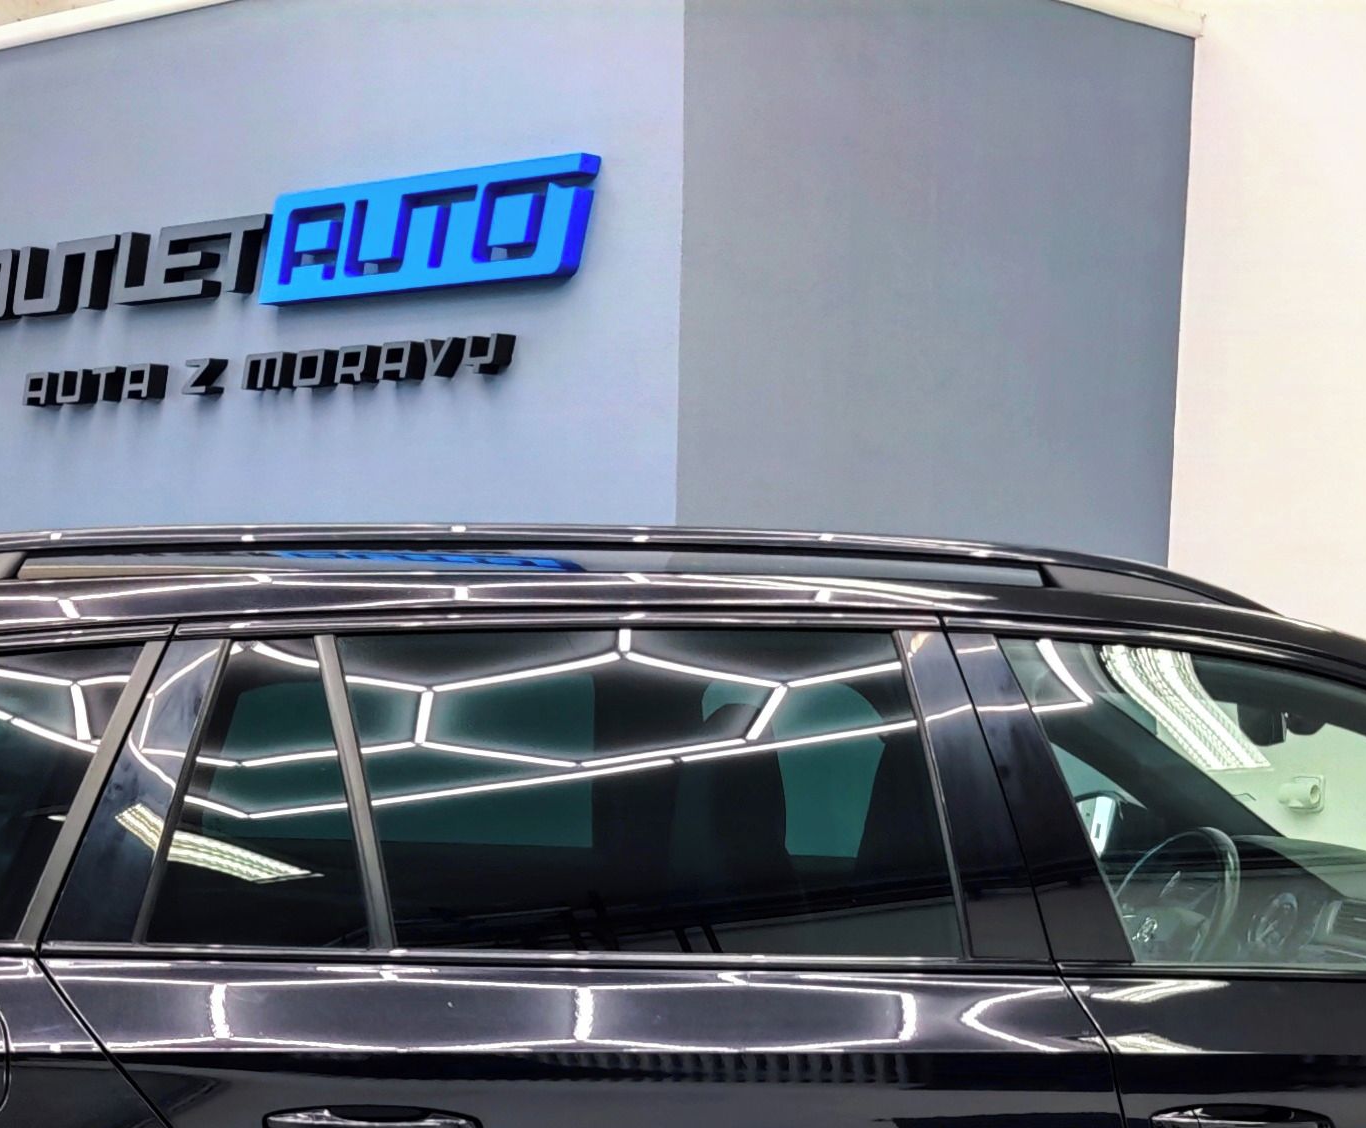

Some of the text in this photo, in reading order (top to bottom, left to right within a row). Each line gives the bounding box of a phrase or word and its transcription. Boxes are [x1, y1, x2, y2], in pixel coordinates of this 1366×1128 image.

[23, 333, 517, 406] AUTA Z MORAVY
